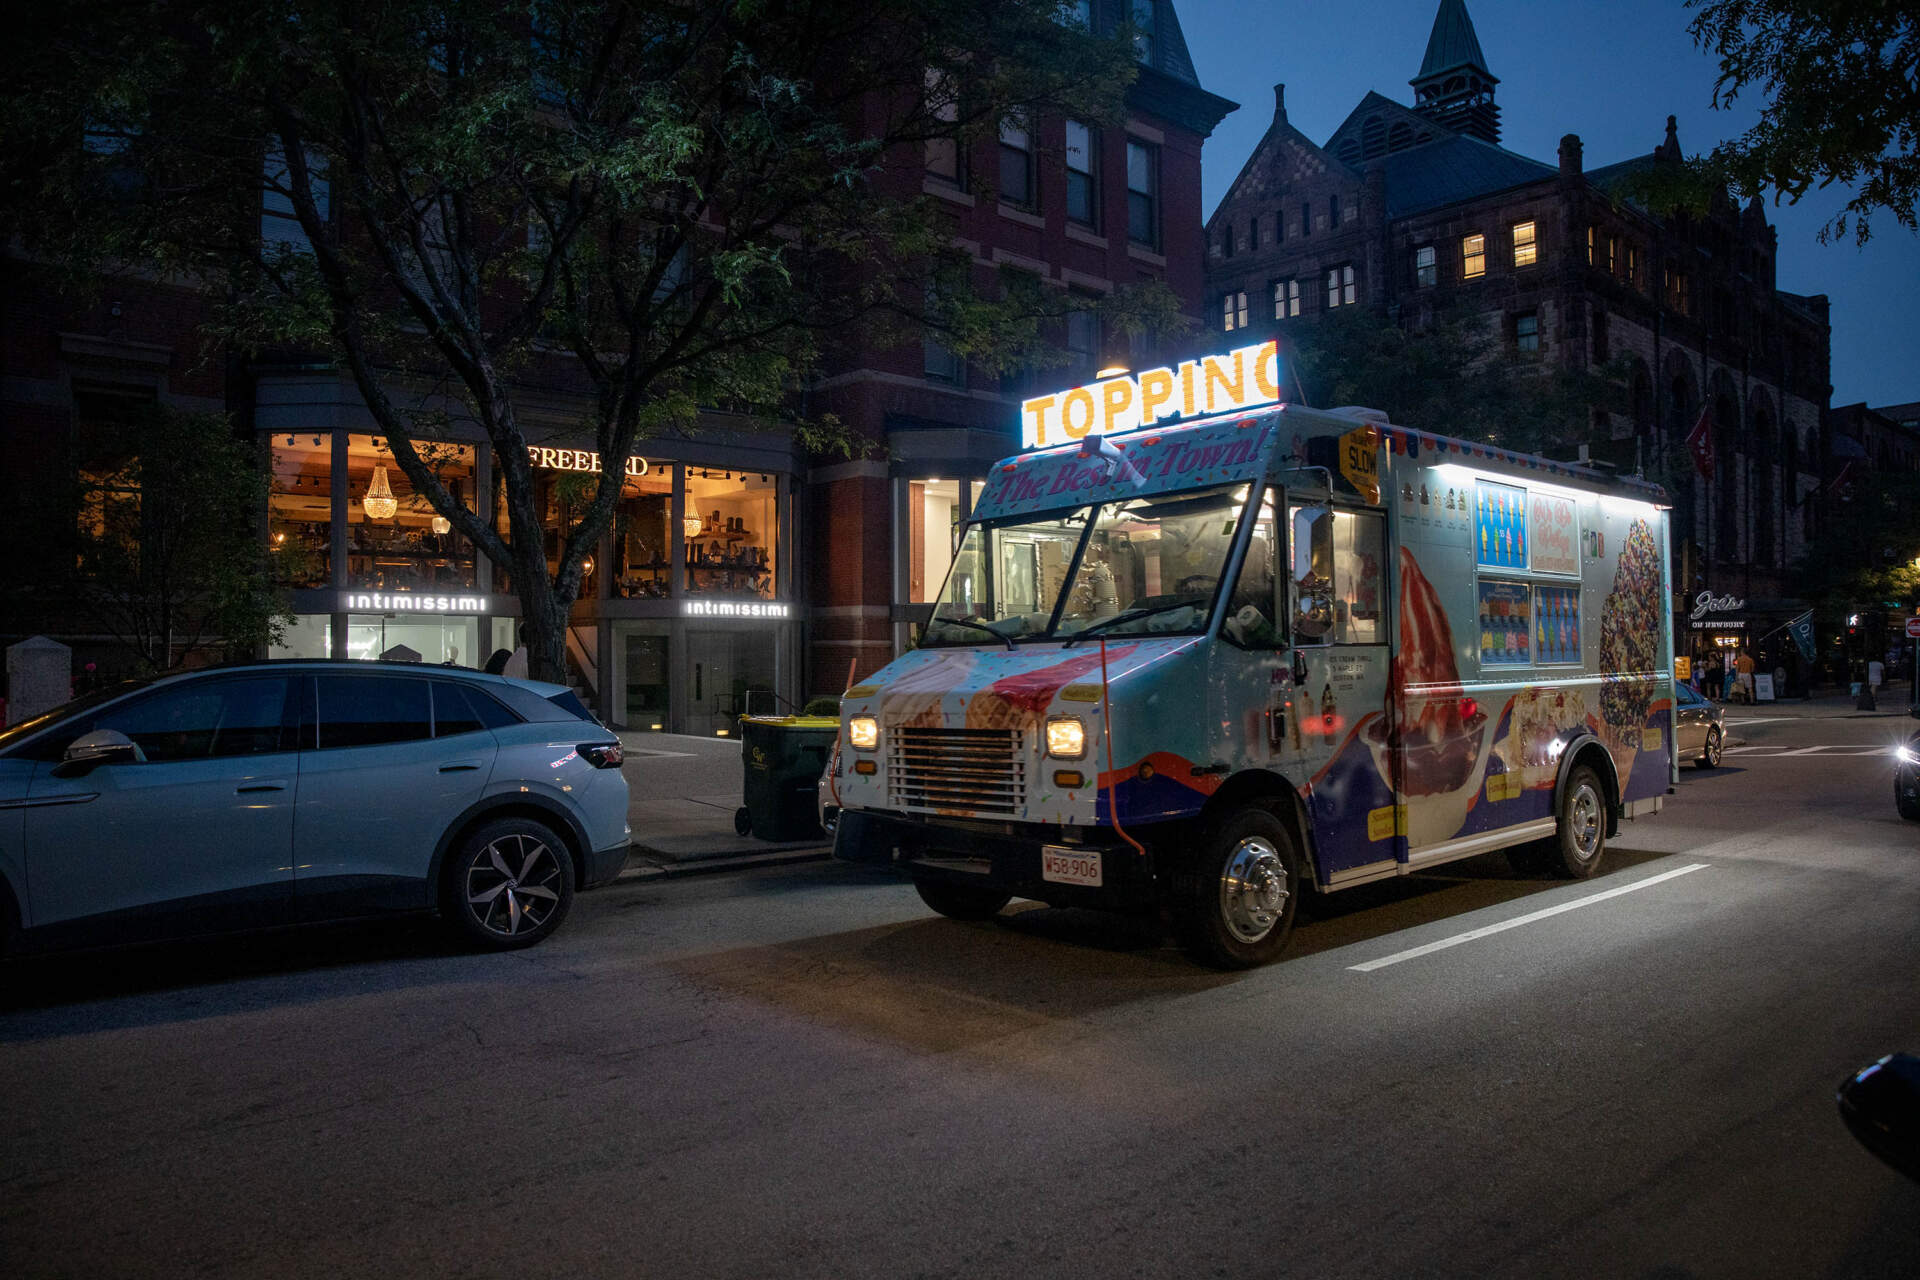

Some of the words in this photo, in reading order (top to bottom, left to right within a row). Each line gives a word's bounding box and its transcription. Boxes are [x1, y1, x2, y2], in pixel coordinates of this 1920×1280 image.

[995, 470, 1048, 505] The
[1155, 427, 1269, 477] Town!
[1349, 446, 1377, 475] SLOW
[348, 593, 486, 611] intimissimi
[687, 600, 788, 617] intimissimi
[1691, 590, 1744, 620] Joe's
